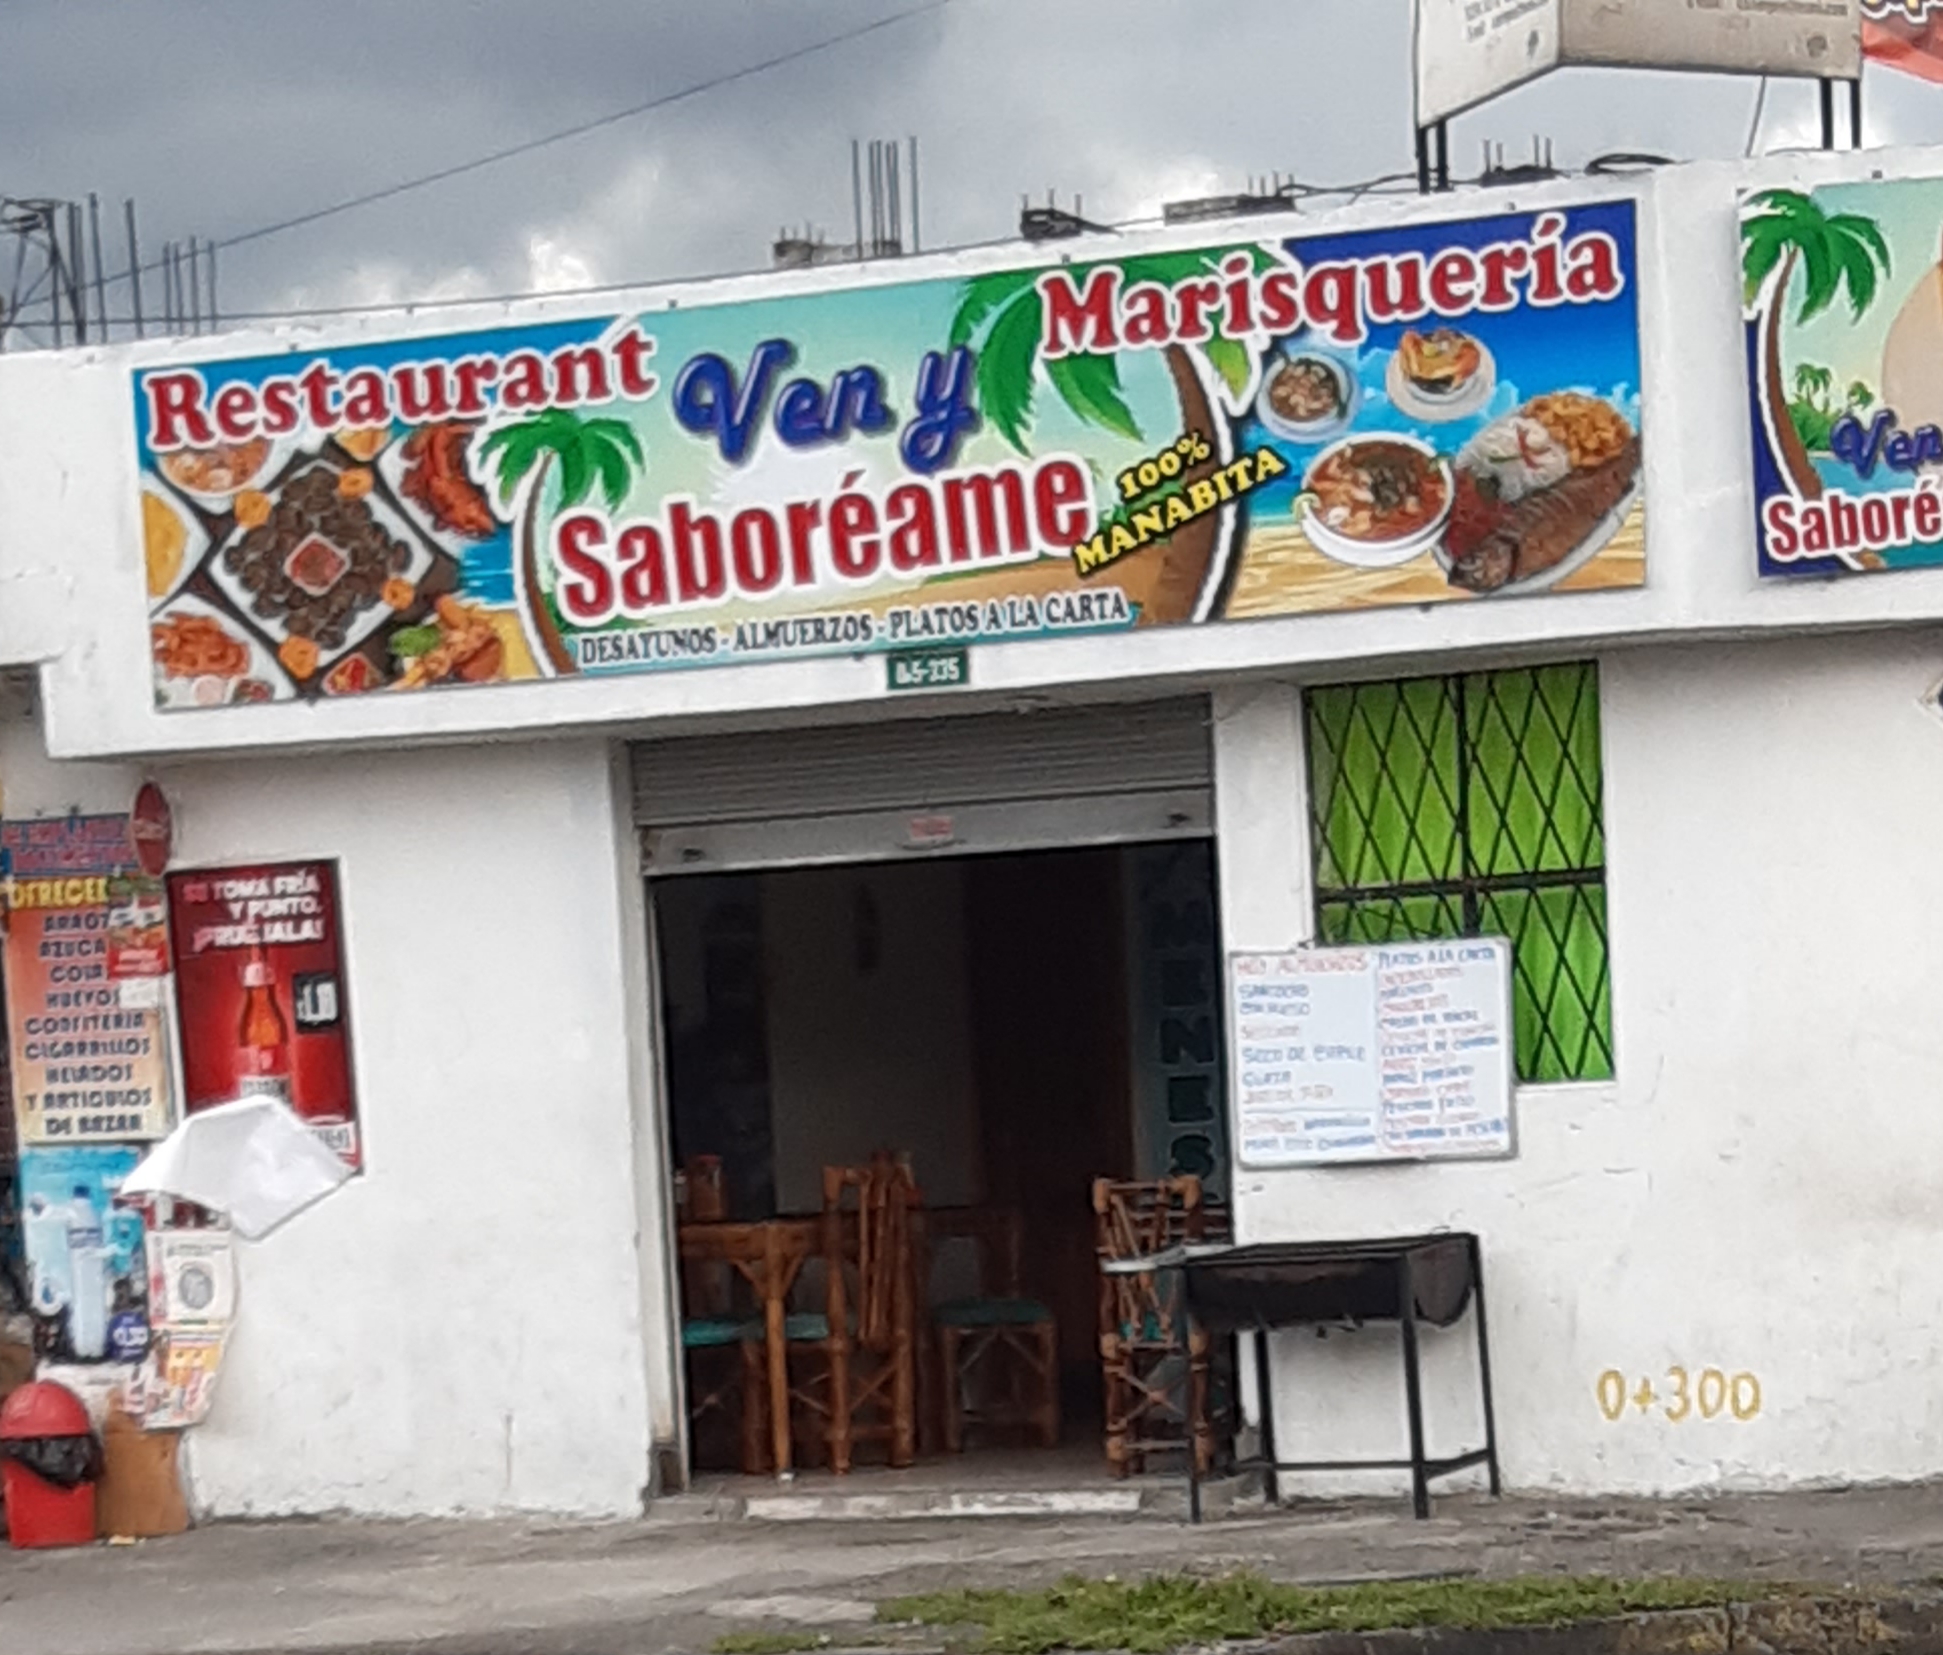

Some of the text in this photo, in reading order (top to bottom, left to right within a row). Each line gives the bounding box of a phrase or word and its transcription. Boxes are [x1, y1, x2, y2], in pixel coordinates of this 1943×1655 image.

[1039, 214, 1619, 356] Marisquería
[146, 328, 657, 449] Restaurant
[673, 338, 980, 475] Ven y
[1072, 447, 1286, 576] MANABITA
[1115, 432, 1212, 499] 100%
[557, 460, 1090, 619] Saboréame
[581, 628, 717, 665] DESAYUNOS
[733, 614, 874, 652] ALMUERZOS
[889, 605, 979, 640] PLATOS
[985, 604, 1001, 629] A
[1005, 601, 1039, 628] LA
[1045, 593, 1127, 625] CARTA
[211, 877, 270, 900] TOMA
[228, 900, 245, 920] Y
